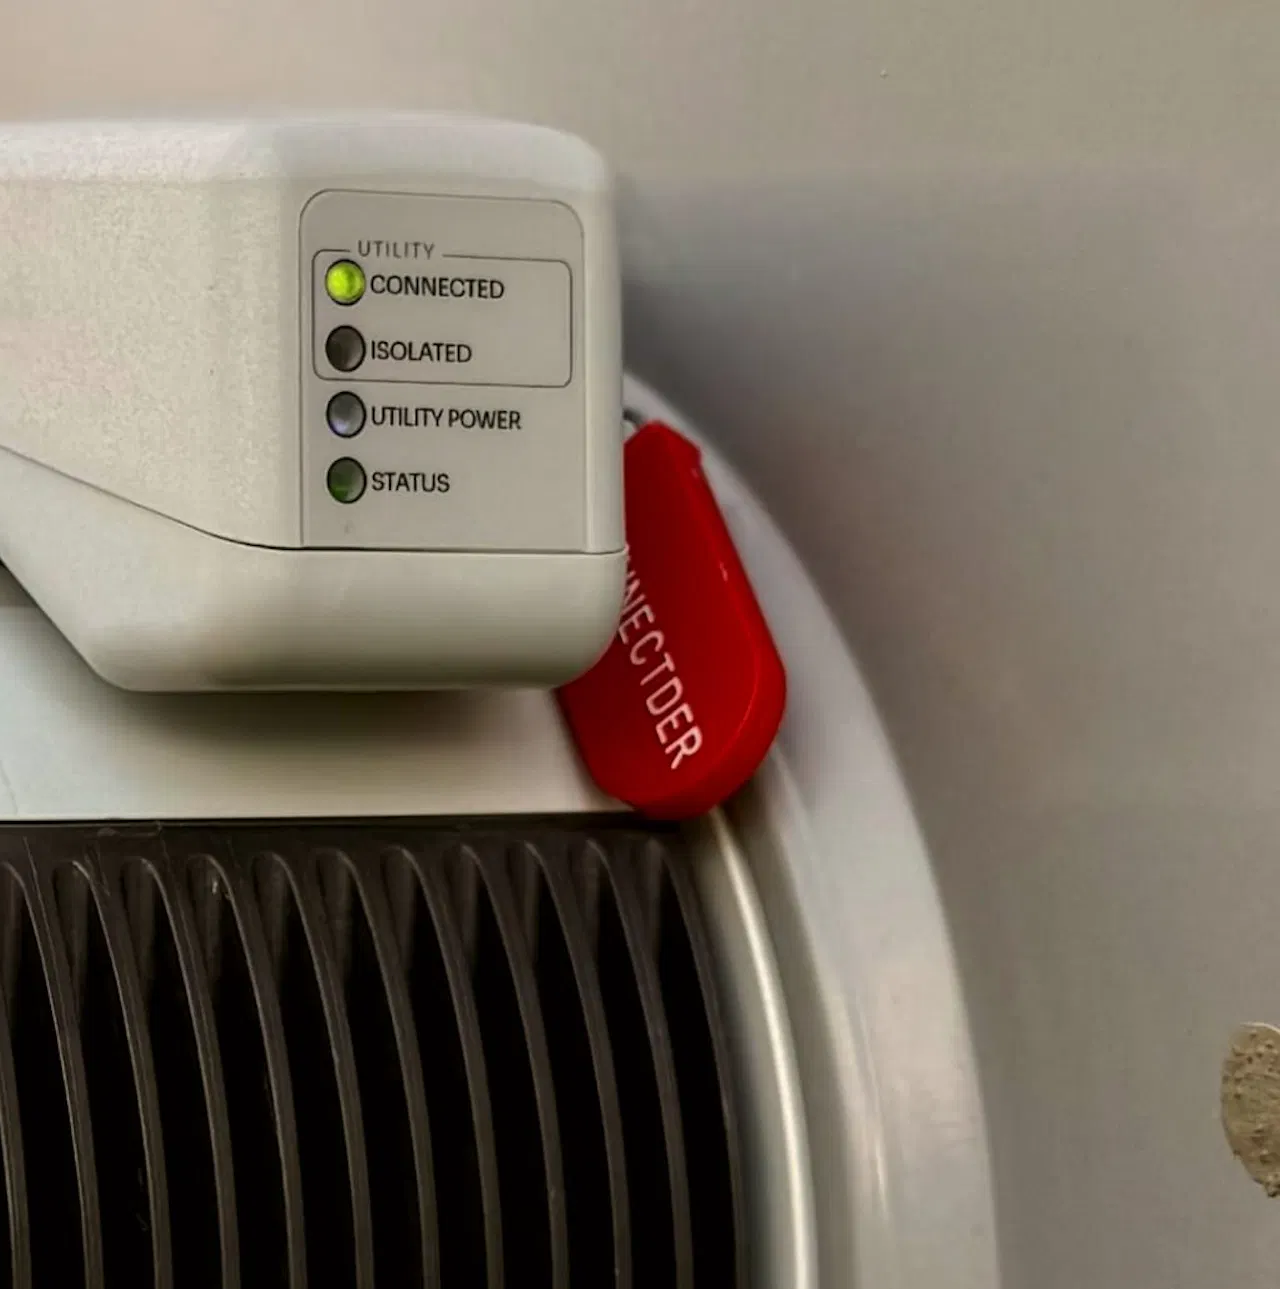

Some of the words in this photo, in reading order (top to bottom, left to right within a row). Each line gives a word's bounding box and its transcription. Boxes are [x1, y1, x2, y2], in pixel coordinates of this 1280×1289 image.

[356, 239, 436, 260] UTILITY
[369, 274, 505, 299] CONNECTED
[370, 340, 473, 363] ISOLATED
[371, 406, 444, 428] UTILITY
[448, 408, 522, 430] POWER
[371, 471, 451, 493] STATUS
